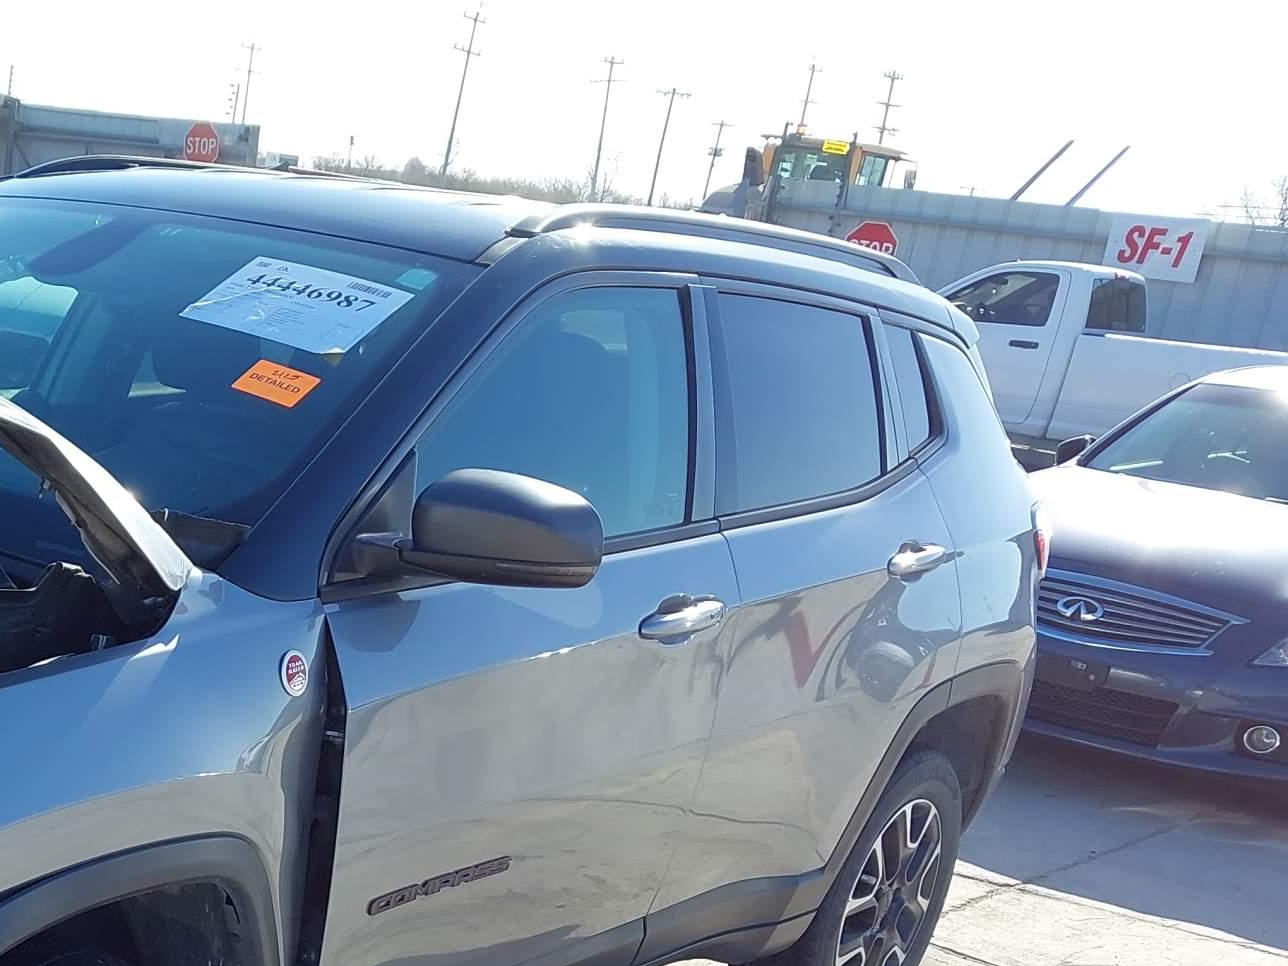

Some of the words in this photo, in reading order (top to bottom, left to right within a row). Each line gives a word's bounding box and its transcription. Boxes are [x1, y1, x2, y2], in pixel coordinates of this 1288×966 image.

[186, 137, 217, 155] STOP
[850, 239, 893, 254] OP
[1117, 225, 1194, 268] SF-1
[246, 273, 376, 312] 44446987
[249, 372, 301, 394] DETAILED
[366, 856, 512, 916] COMPASS
